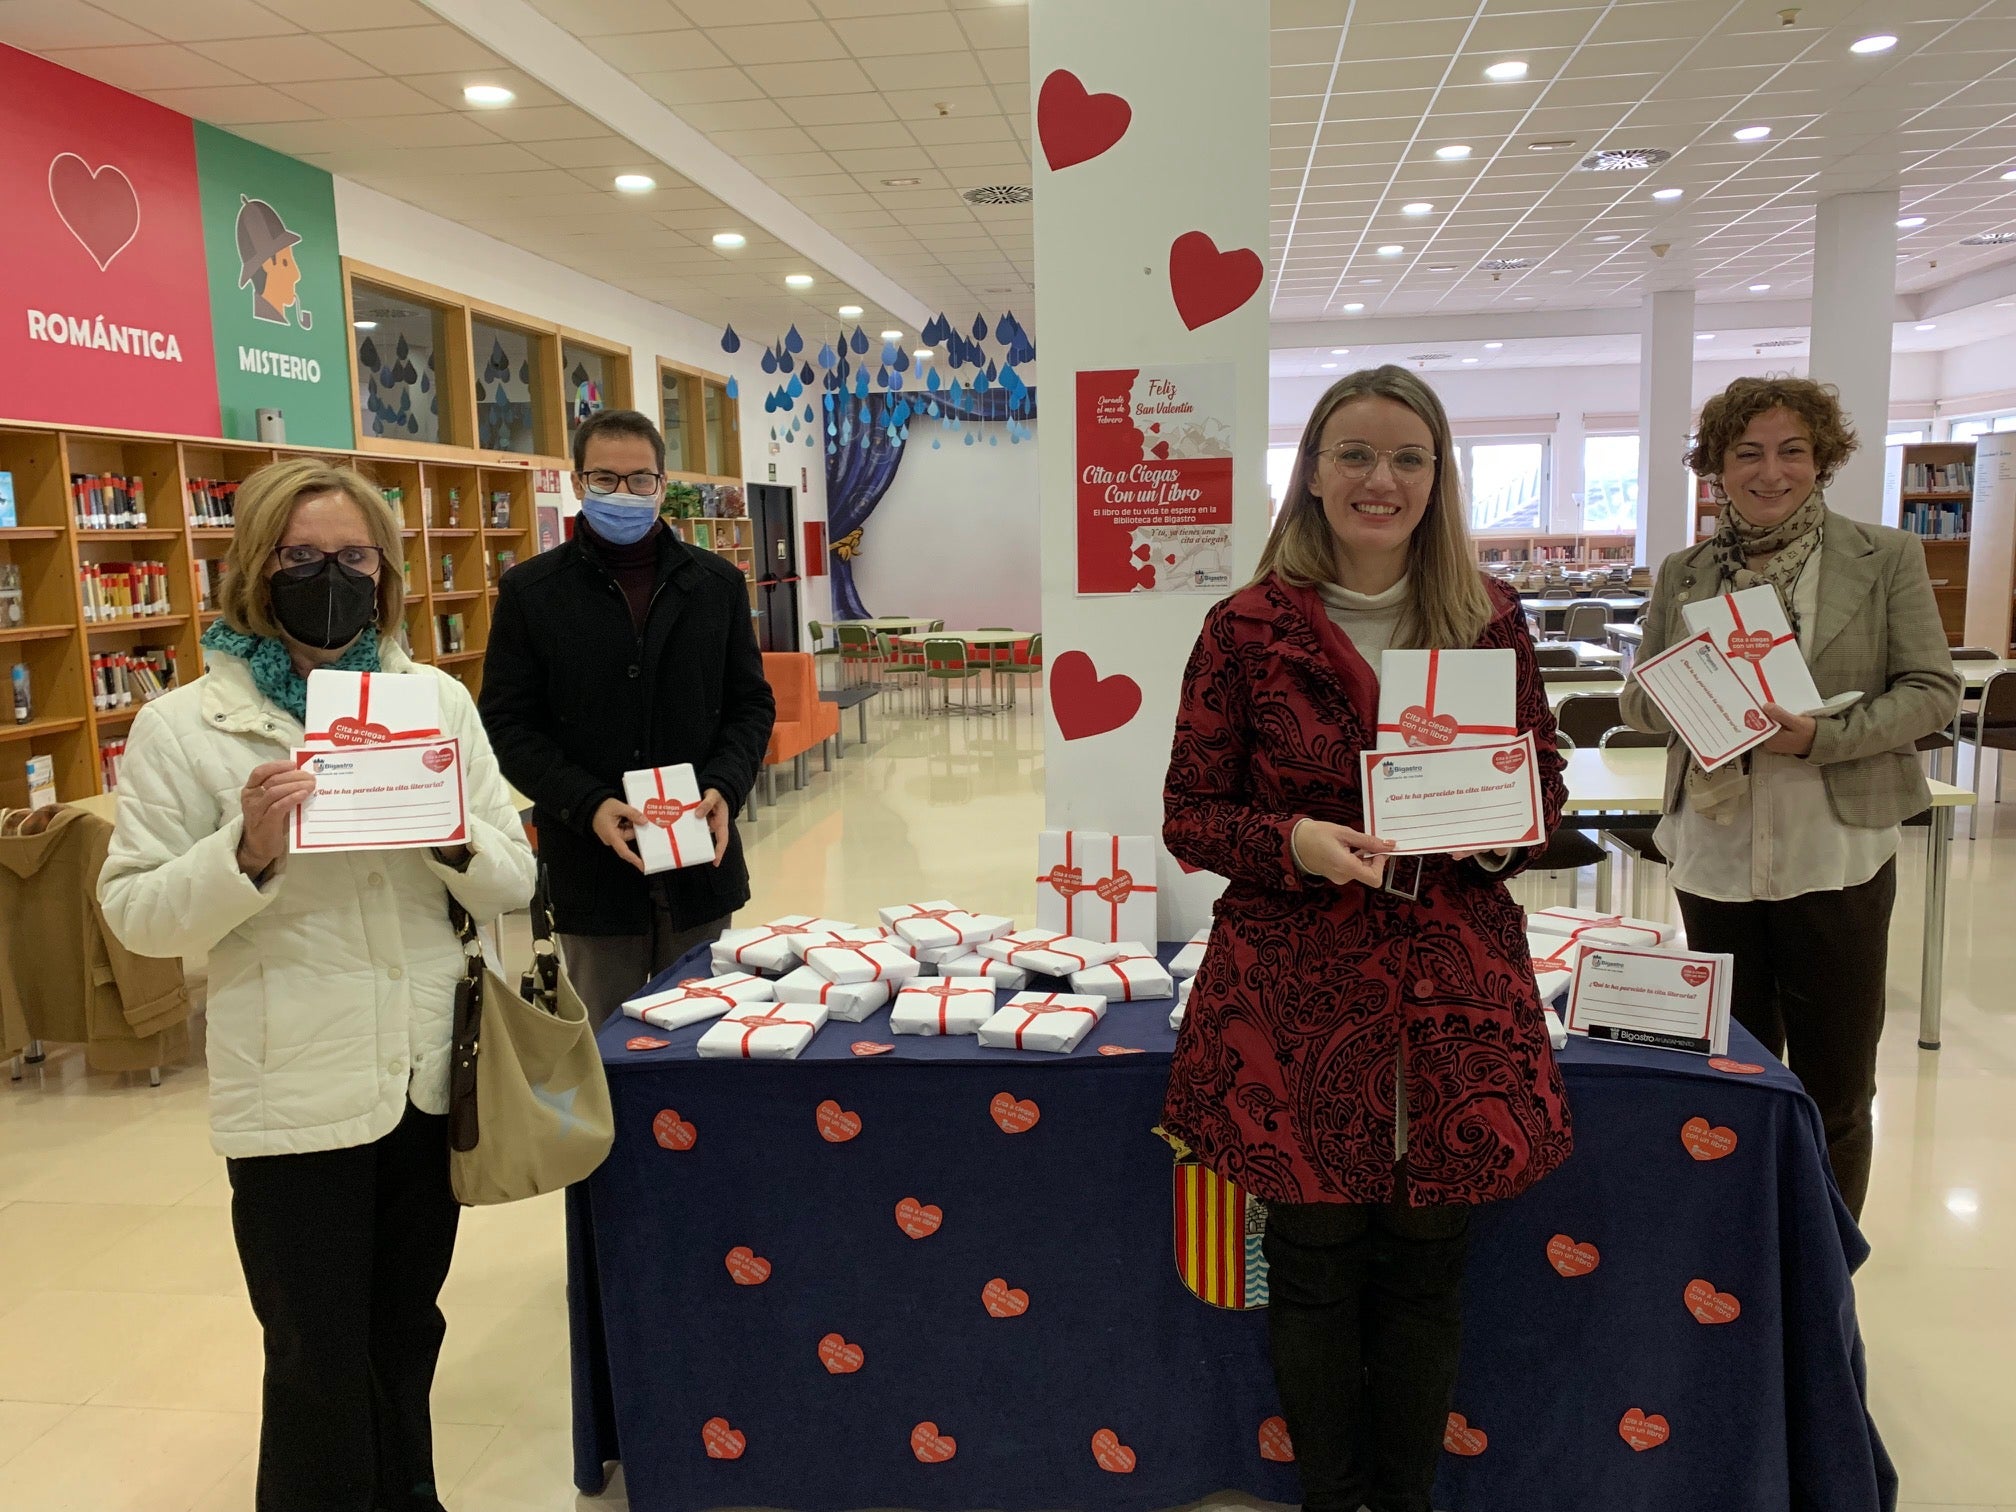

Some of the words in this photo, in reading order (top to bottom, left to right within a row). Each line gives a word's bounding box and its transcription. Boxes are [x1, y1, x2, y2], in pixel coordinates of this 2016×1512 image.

[27, 309, 182, 363] ROMÁNTICA
[238, 346, 321, 384] MISTERIO
[1148, 379, 1177, 400] Feliz
[1098, 396, 1125, 405] Durante
[1136, 404, 1155, 416] San
[1156, 402, 1193, 415] Valentín
[1097, 415, 1123, 424] Febrero
[1083, 465, 1115, 484] Cita
[1116, 470, 1129, 482] a
[1129, 464, 1180, 487] Ciegas
[1104, 485, 1138, 503] Con
[1138, 489, 1158, 503] un
[1158, 483, 1202, 506] Libro
[1102, 508, 1120, 516] libro
[1122, 507, 1132, 515] de
[1144, 507, 1159, 515] vida
[1171, 507, 1196, 515] espera
[1198, 506, 1207, 514] en
[1209, 505, 1217, 513] la
[1113, 516, 1150, 524] Biblioteca
[1164, 515, 1196, 524] Bigastro
[1402, 721, 1417, 730] con
[1430, 730, 1449, 742] libro
[1405, 712, 1421, 723] Cita
[1428, 721, 1453, 734] ciegas
[334, 732, 349, 740] con
[336, 724, 352, 733] Cita
[361, 730, 385, 741] ciegas
[1394, 765, 1422, 773] Bigastro
[353, 787, 385, 795] parecido
[410, 781, 444, 790] literaria?
[1385, 794, 1403, 803] ¿Qué
[1423, 790, 1455, 800] parecido
[1481, 782, 1515, 792] literaria?
[1621, 1031, 1654, 1043] Bigastro
[1686, 1132, 1698, 1140] con
[1711, 1140, 1728, 1150] libro
[1689, 1125, 1703, 1133] Cita
[1708, 1133, 1731, 1145] ciegas
[1553, 1241, 1566, 1249] Cita
[1572, 1249, 1595, 1261] ciegas
[1575, 1256, 1592, 1267] libro
[1689, 1293, 1702, 1302] con
[1714, 1305, 1732, 1318] libro
[1692, 1286, 1706, 1296] Cita
[1712, 1297, 1736, 1313] ciegas
[1644, 1422, 1666, 1433] ciegas
[1646, 1430, 1663, 1439] libro
